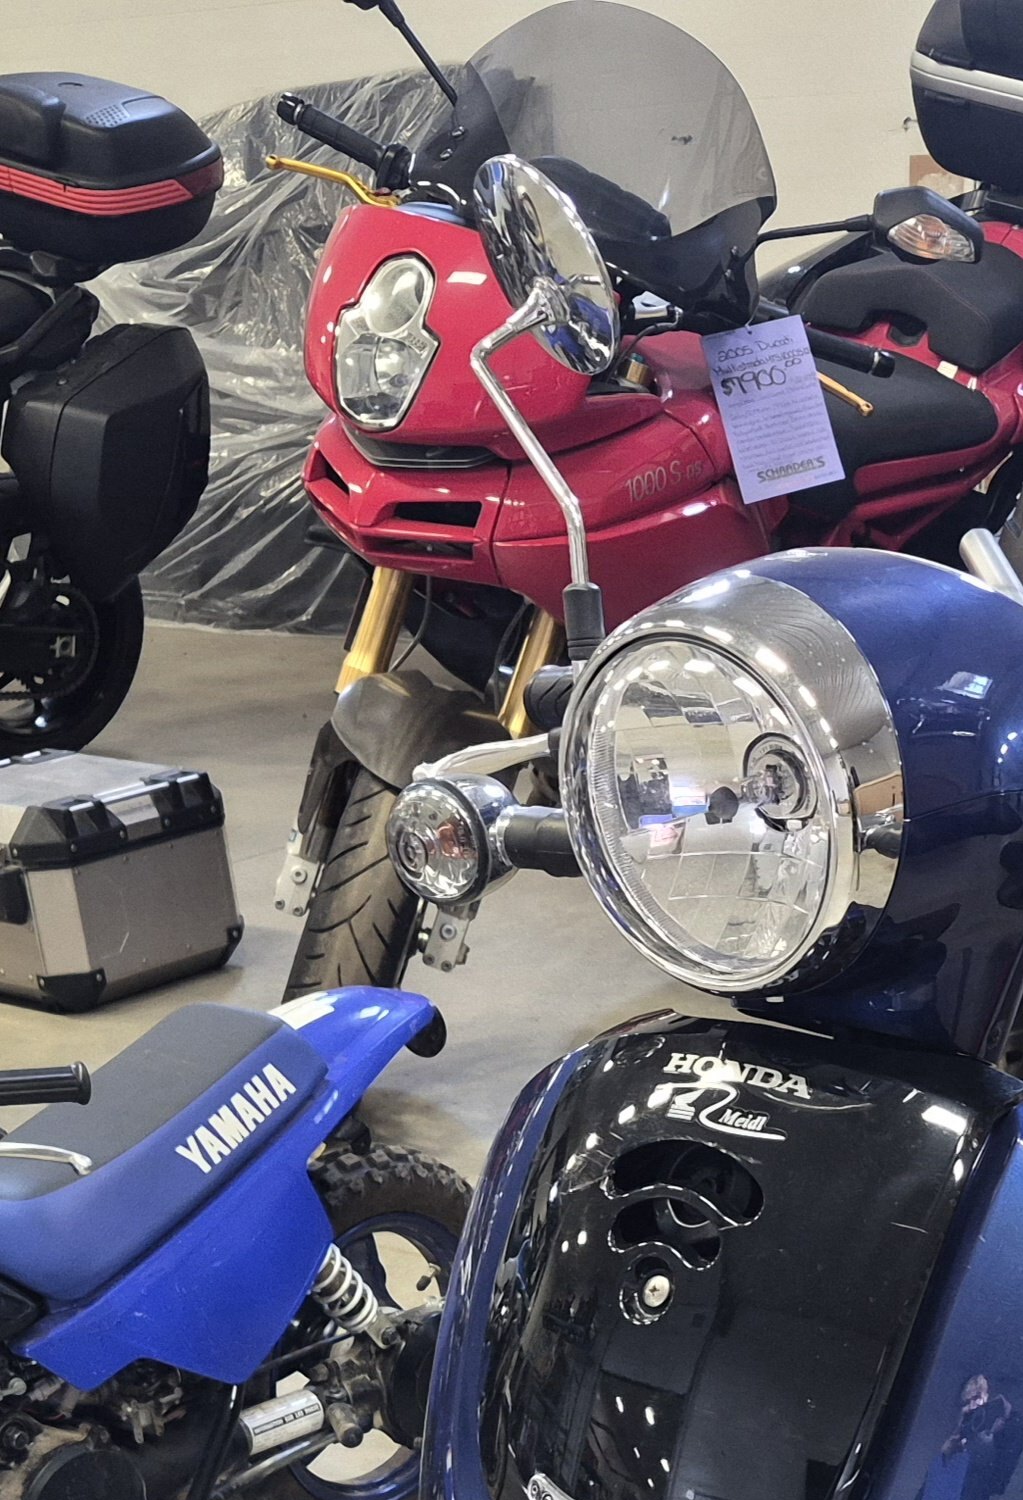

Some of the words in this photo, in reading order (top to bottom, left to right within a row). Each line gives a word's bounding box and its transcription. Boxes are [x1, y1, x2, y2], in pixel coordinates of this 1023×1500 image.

[717, 345, 755, 363] 2005
[755, 336, 794, 351] Ducati
[625, 466, 667, 502] 1000
[669, 460, 682, 485] S
[663, 1052, 812, 1099] HONDA
[175, 1063, 297, 1174] YAMAHA
[718, 1109, 769, 1131] Meidl
